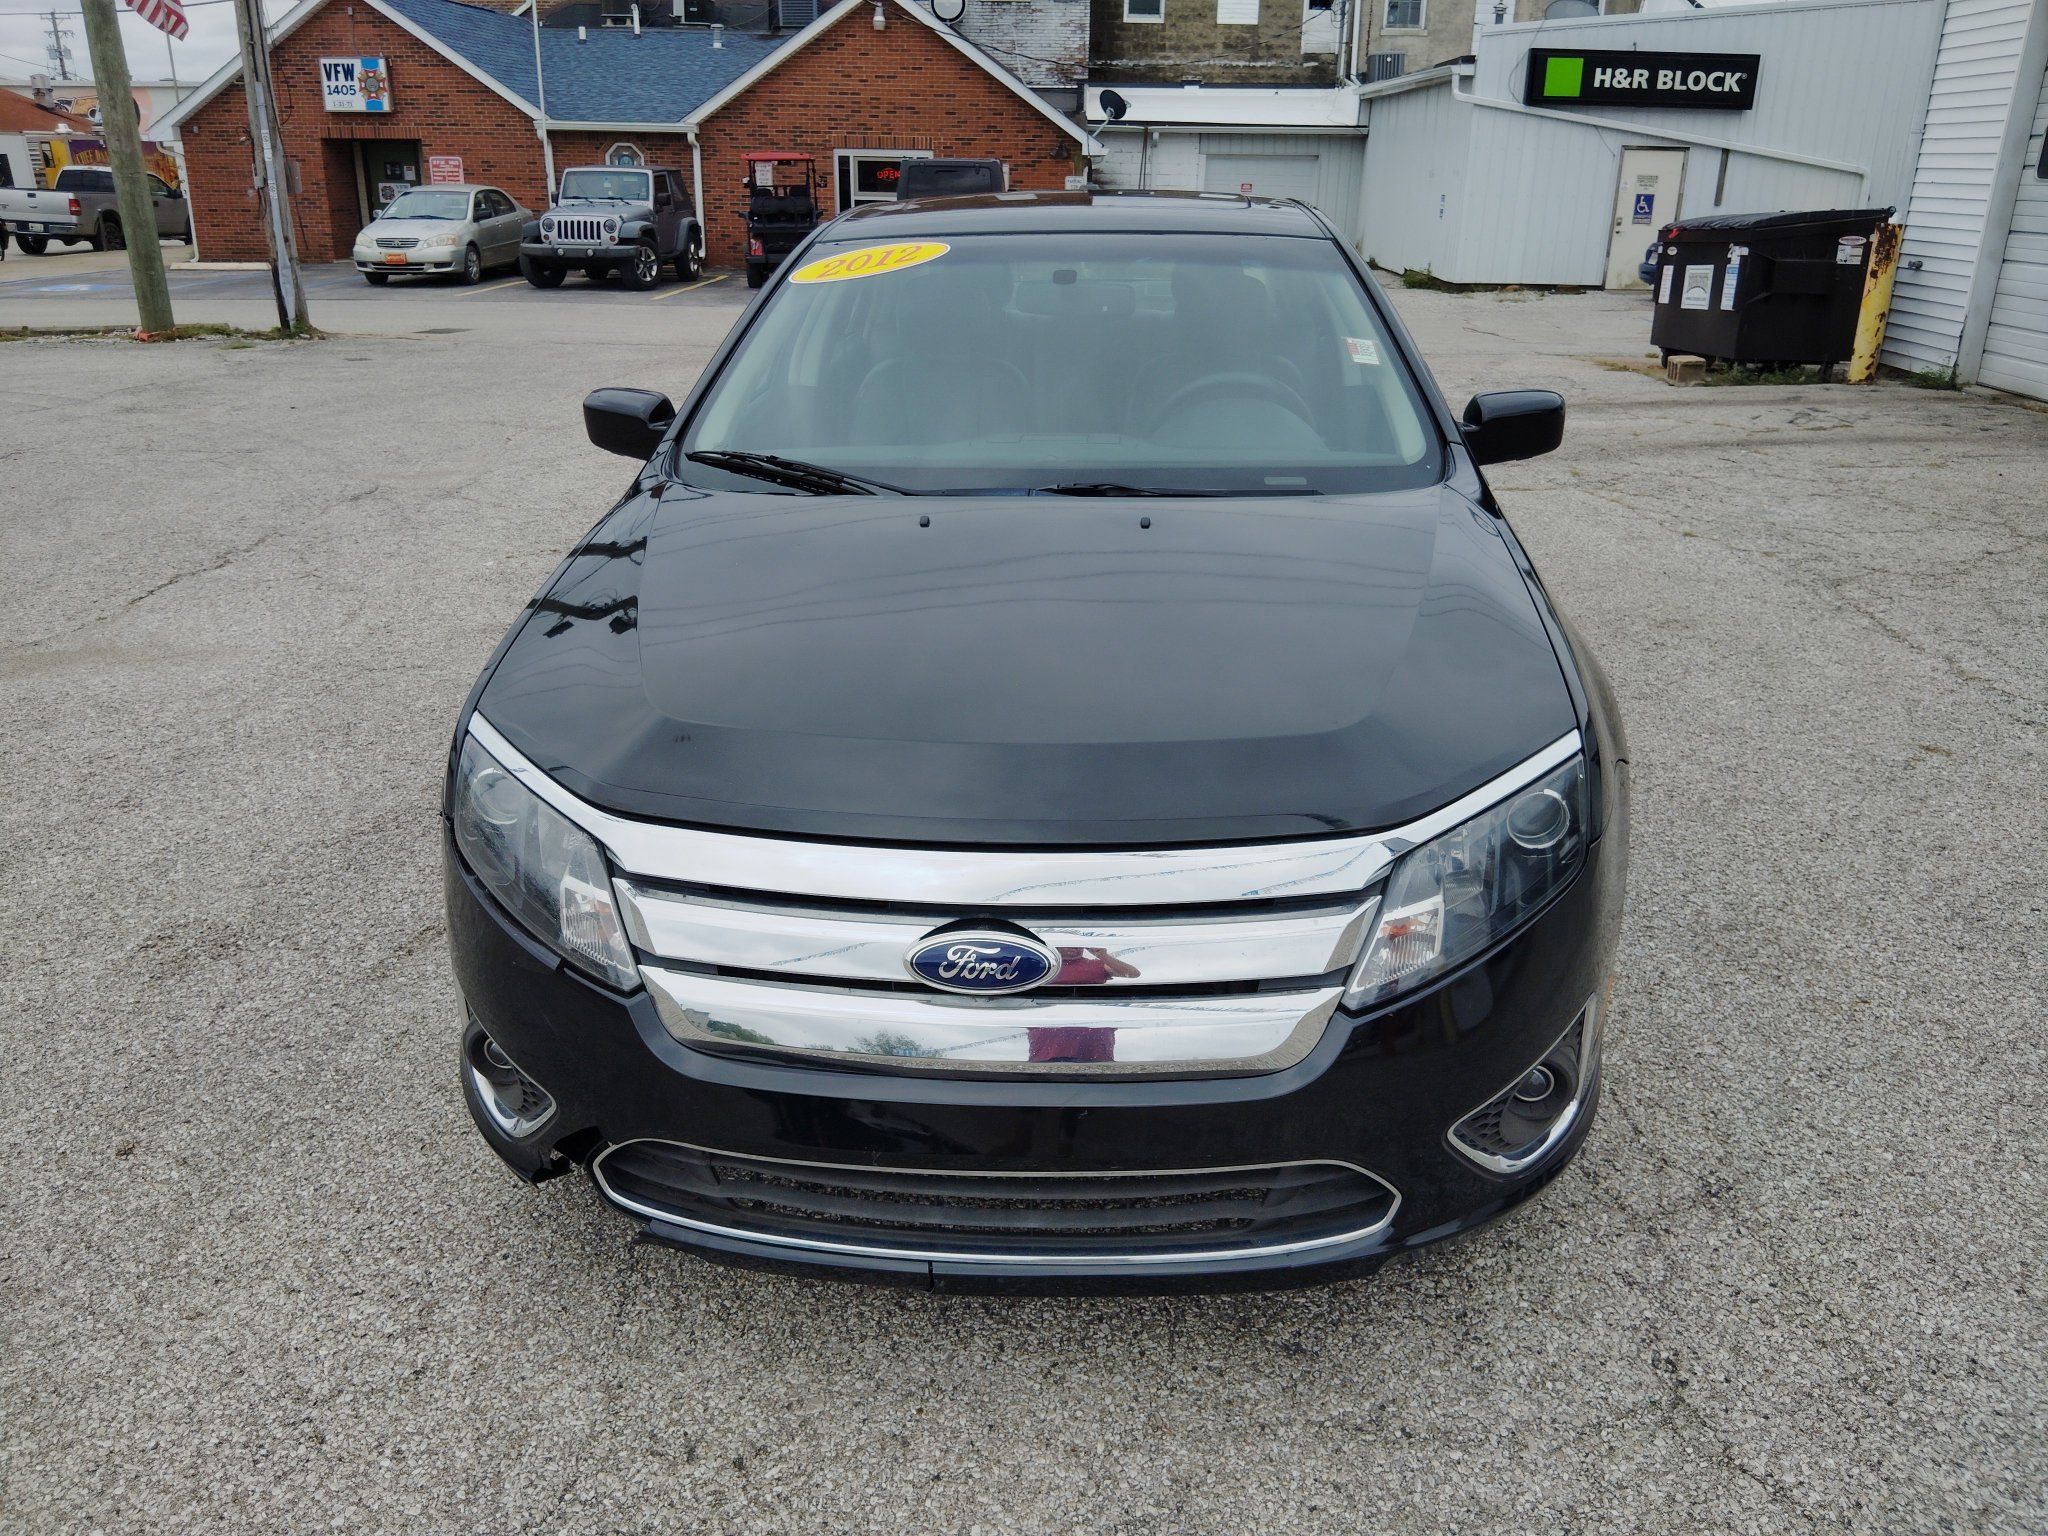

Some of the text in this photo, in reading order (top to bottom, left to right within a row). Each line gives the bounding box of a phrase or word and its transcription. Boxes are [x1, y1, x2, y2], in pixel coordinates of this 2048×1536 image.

[323, 63, 355, 81] VFW
[1593, 67, 1649, 89] H&R
[326, 85, 356, 96] 1405
[876, 170, 901, 179] OPEN
[816, 245, 922, 280] 2012
[938, 945, 1023, 980] Ford
